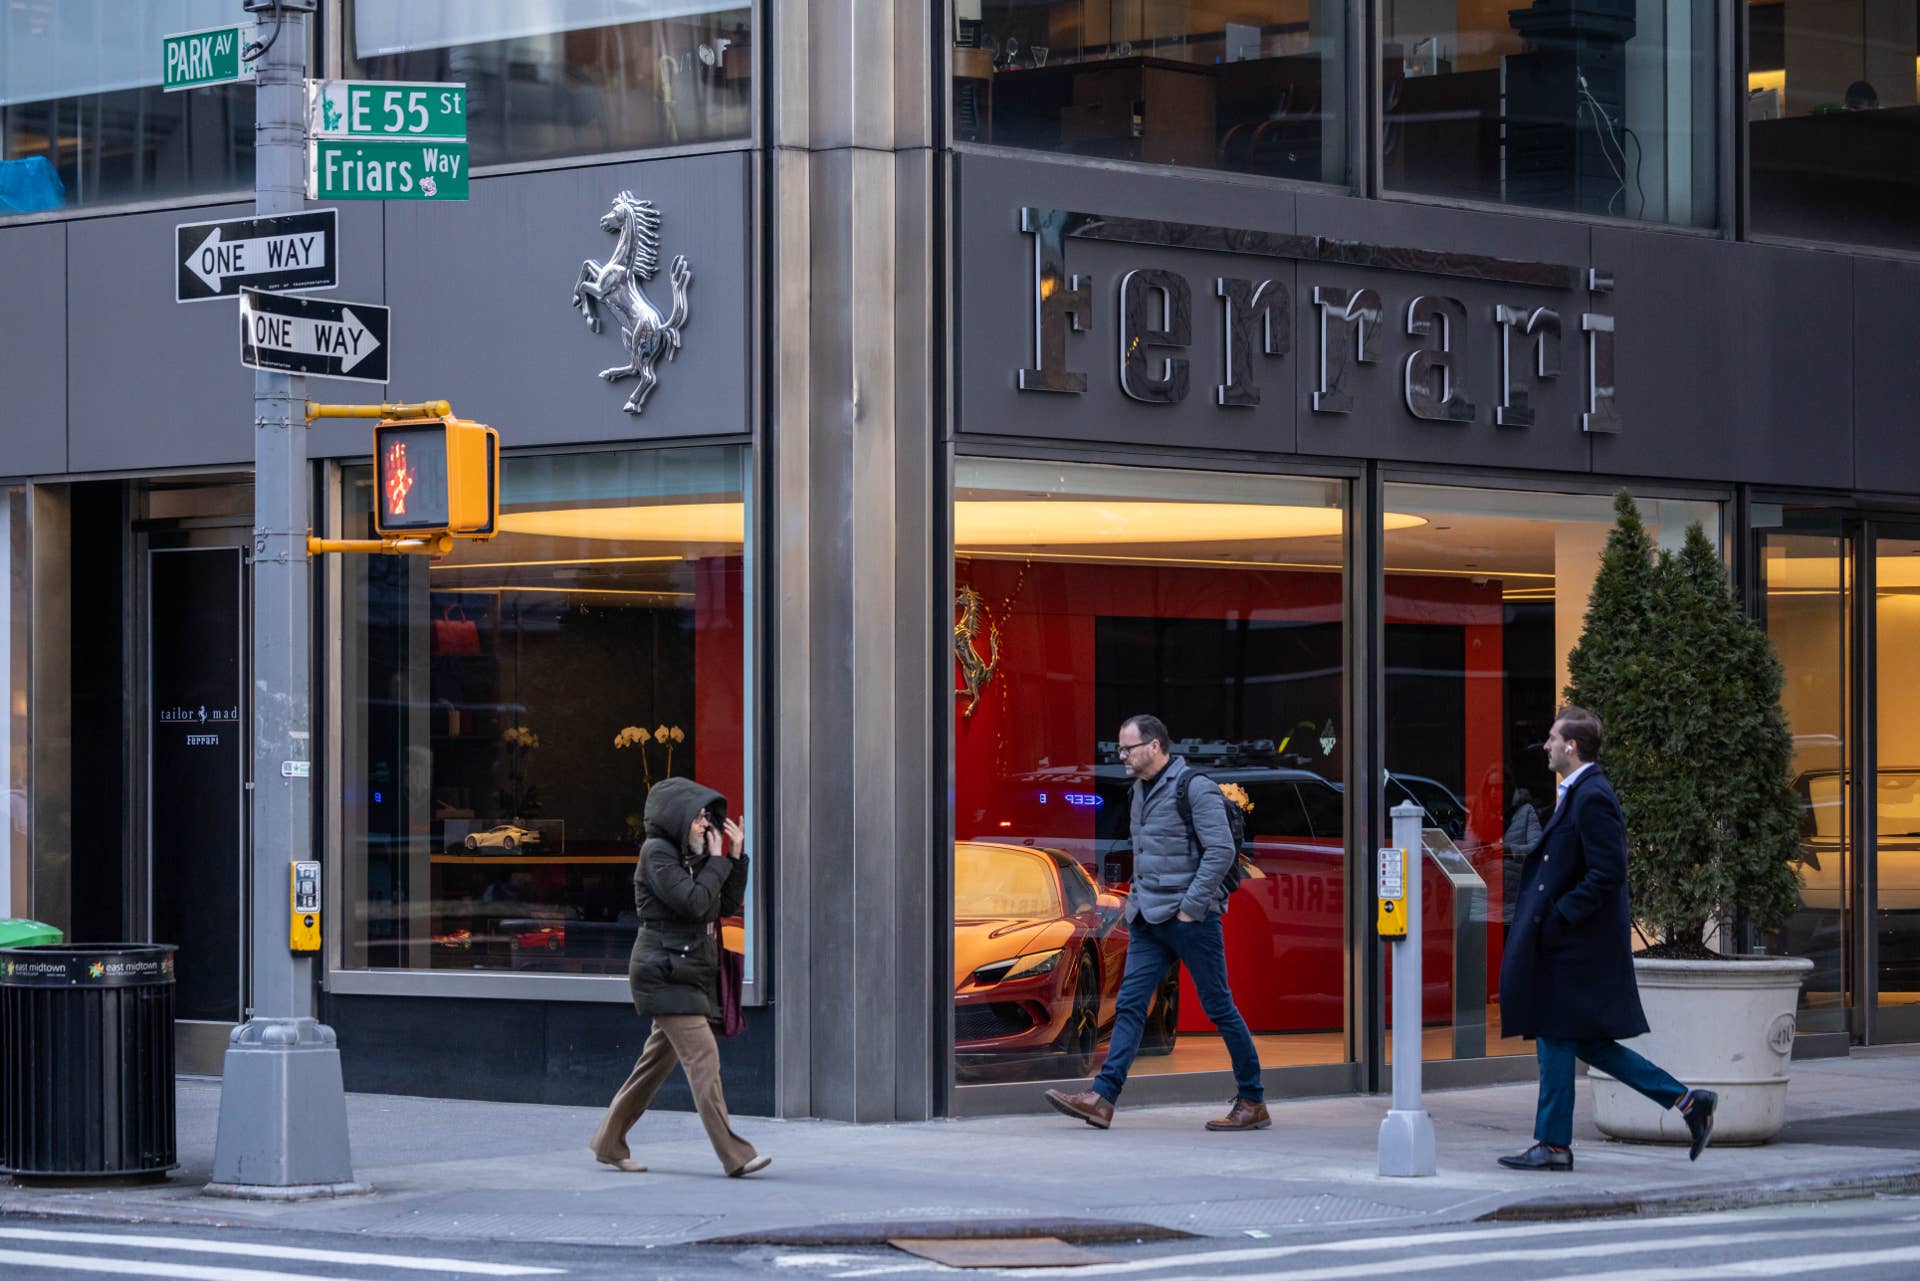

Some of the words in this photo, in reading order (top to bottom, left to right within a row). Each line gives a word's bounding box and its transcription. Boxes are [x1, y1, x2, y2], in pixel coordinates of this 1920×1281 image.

[168, 36, 213, 83] PARK
[214, 33, 232, 57] AV
[352, 90, 372, 131] E
[384, 91, 429, 133] 55
[440, 92, 461, 114] St
[325, 150, 413, 192] Friars
[423, 148, 460, 179] Way
[202, 244, 244, 275] ONE
[267, 237, 315, 268] WAY
[256, 315, 292, 348] ONE
[315, 324, 364, 356] WAY
[1018, 207, 1622, 433] Ferrari
[160, 706, 194, 720] tailor
[213, 706, 237, 720] mad
[15, 963, 28, 972] east
[29, 962, 66, 972] midtown
[106, 963, 124, 971] east
[125, 961, 157, 971] midtown
